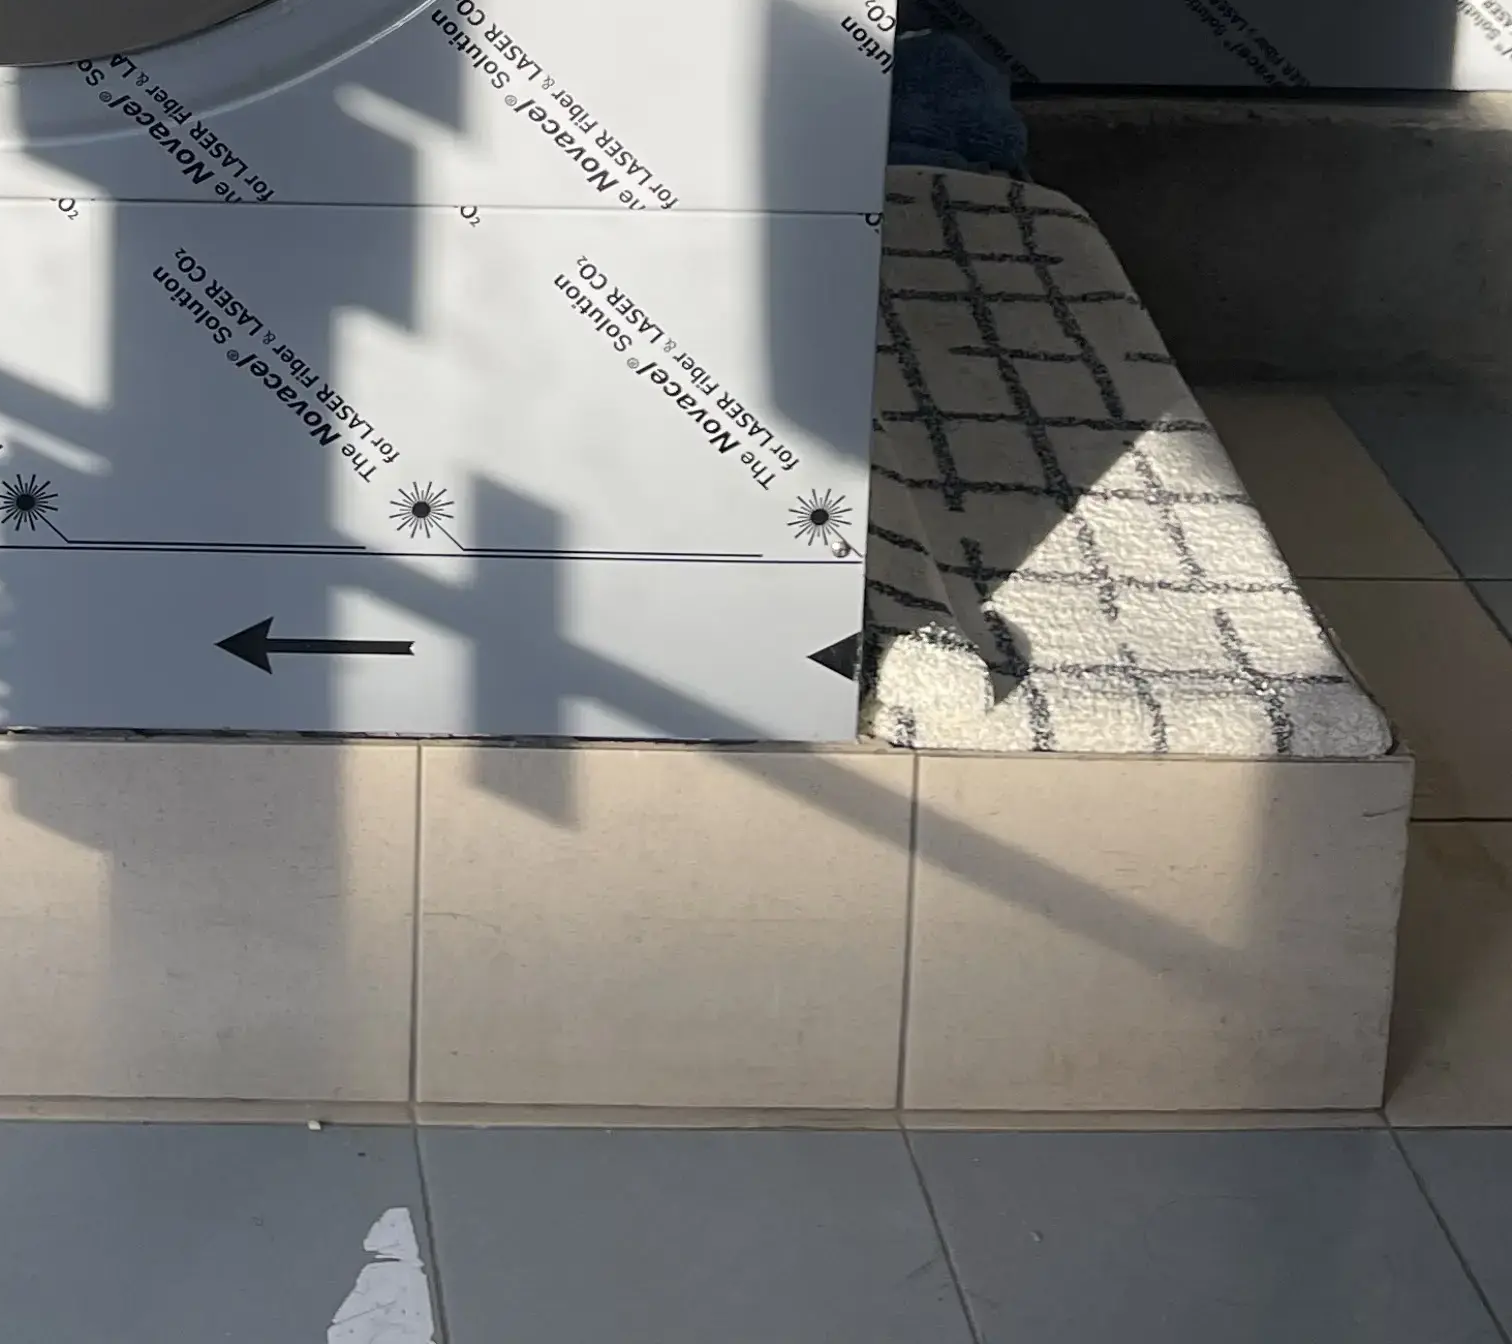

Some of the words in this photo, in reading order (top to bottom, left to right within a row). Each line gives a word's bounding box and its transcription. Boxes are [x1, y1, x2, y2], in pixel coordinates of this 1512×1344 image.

[431, 9, 511, 90] Solution
[484, 23, 543, 81] LASER
[541, 74, 556, 91] &
[550, 89, 599, 134] Fiber
[594, 129, 653, 186] LASER
[648, 183, 679, 210] for
[152, 266, 233, 345] Solution
[204, 279, 264, 337] LASER
[553, 273, 633, 352] Solution
[606, 286, 665, 344] LASER
[262, 329, 277, 346] &
[662, 337, 678, 353] &
[271, 344, 320, 389] Fiber
[672, 352, 720, 396] Fiber
[316, 383, 375, 440] LASER
[716, 391, 775, 448] LASER
[341, 443, 377, 483] The
[370, 437, 400, 464] for
[740, 451, 776, 491] The
[769, 444, 800, 471] for
